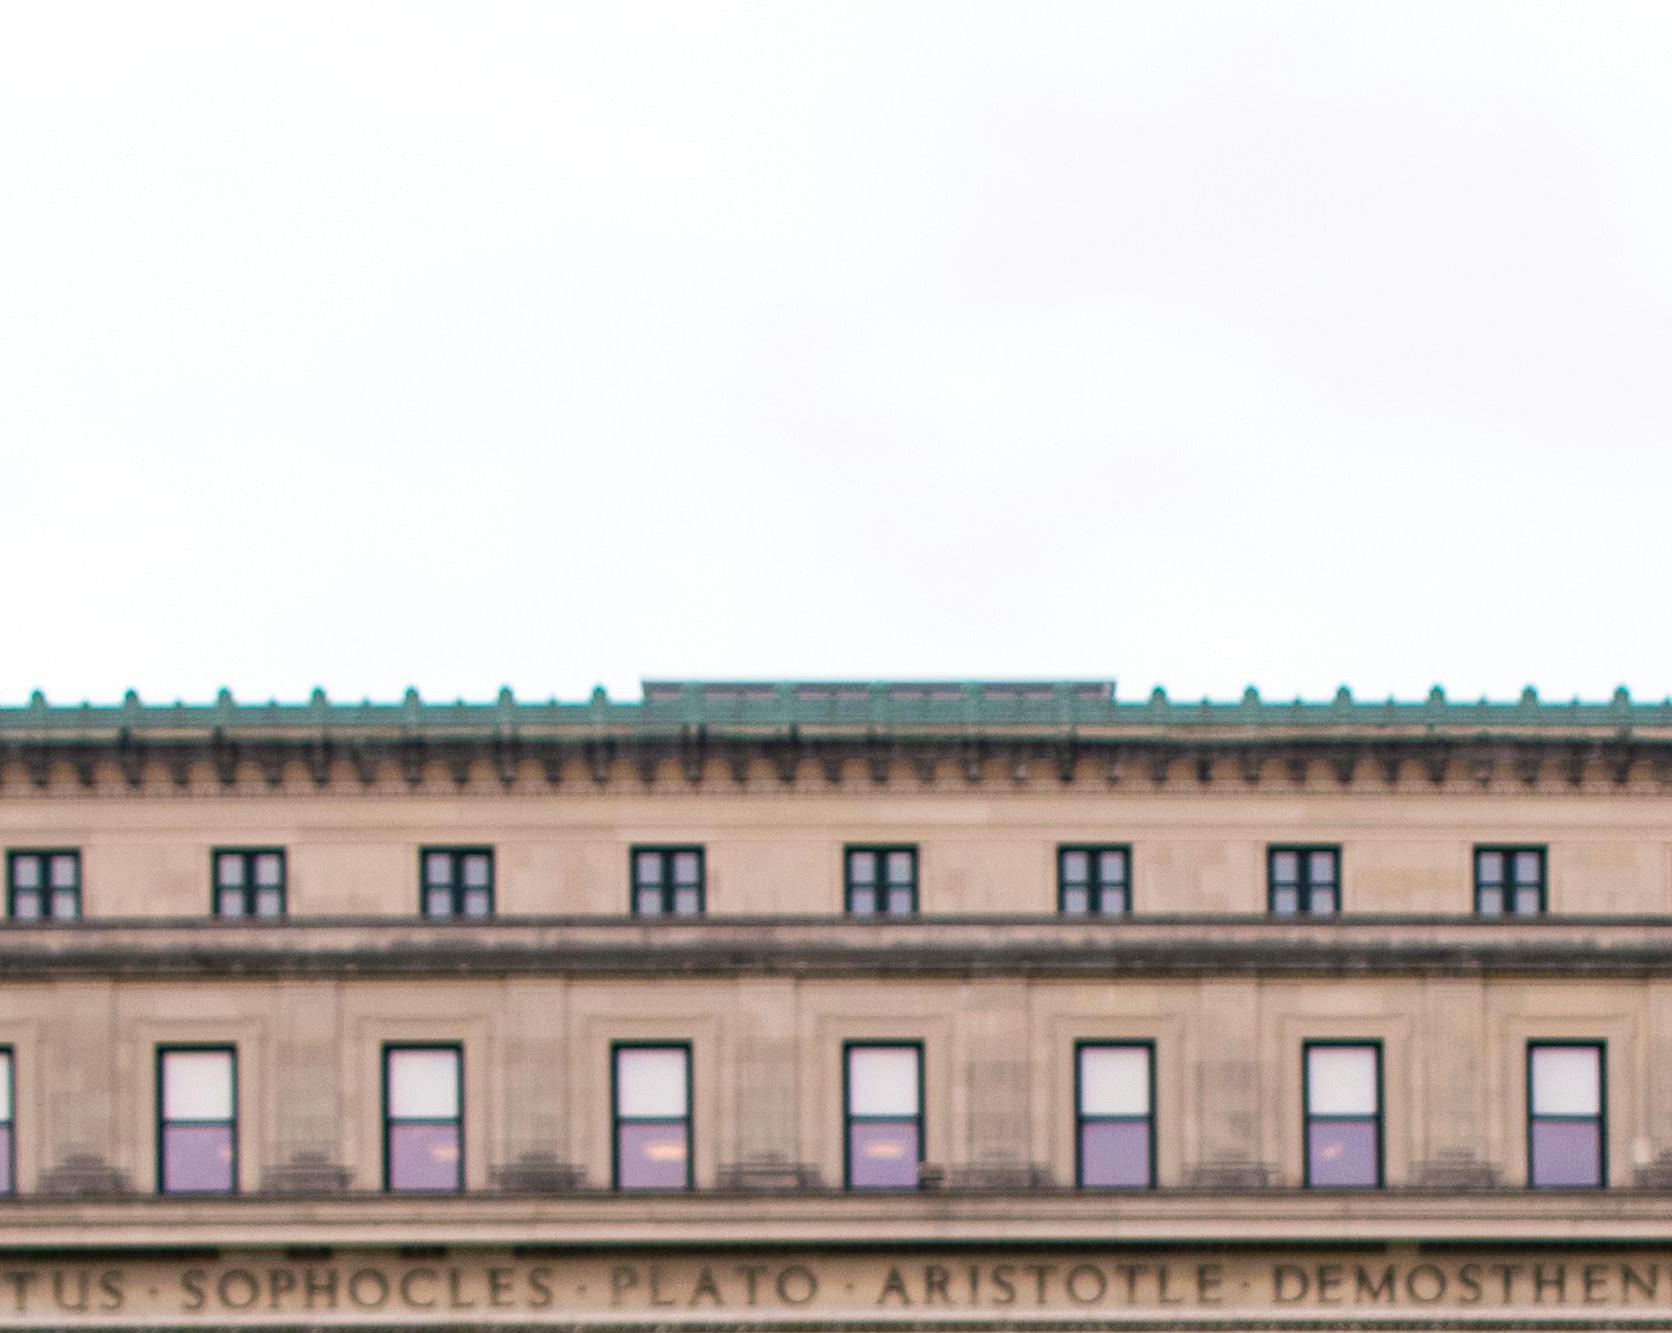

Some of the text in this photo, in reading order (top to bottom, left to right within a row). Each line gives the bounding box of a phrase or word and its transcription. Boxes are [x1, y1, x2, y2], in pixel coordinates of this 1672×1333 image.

[179, 1266, 555, 1313] SOPHOCLES
[609, 1264, 819, 1307] PLATO
[875, 1263, 1225, 1306] ARISTOTLE
